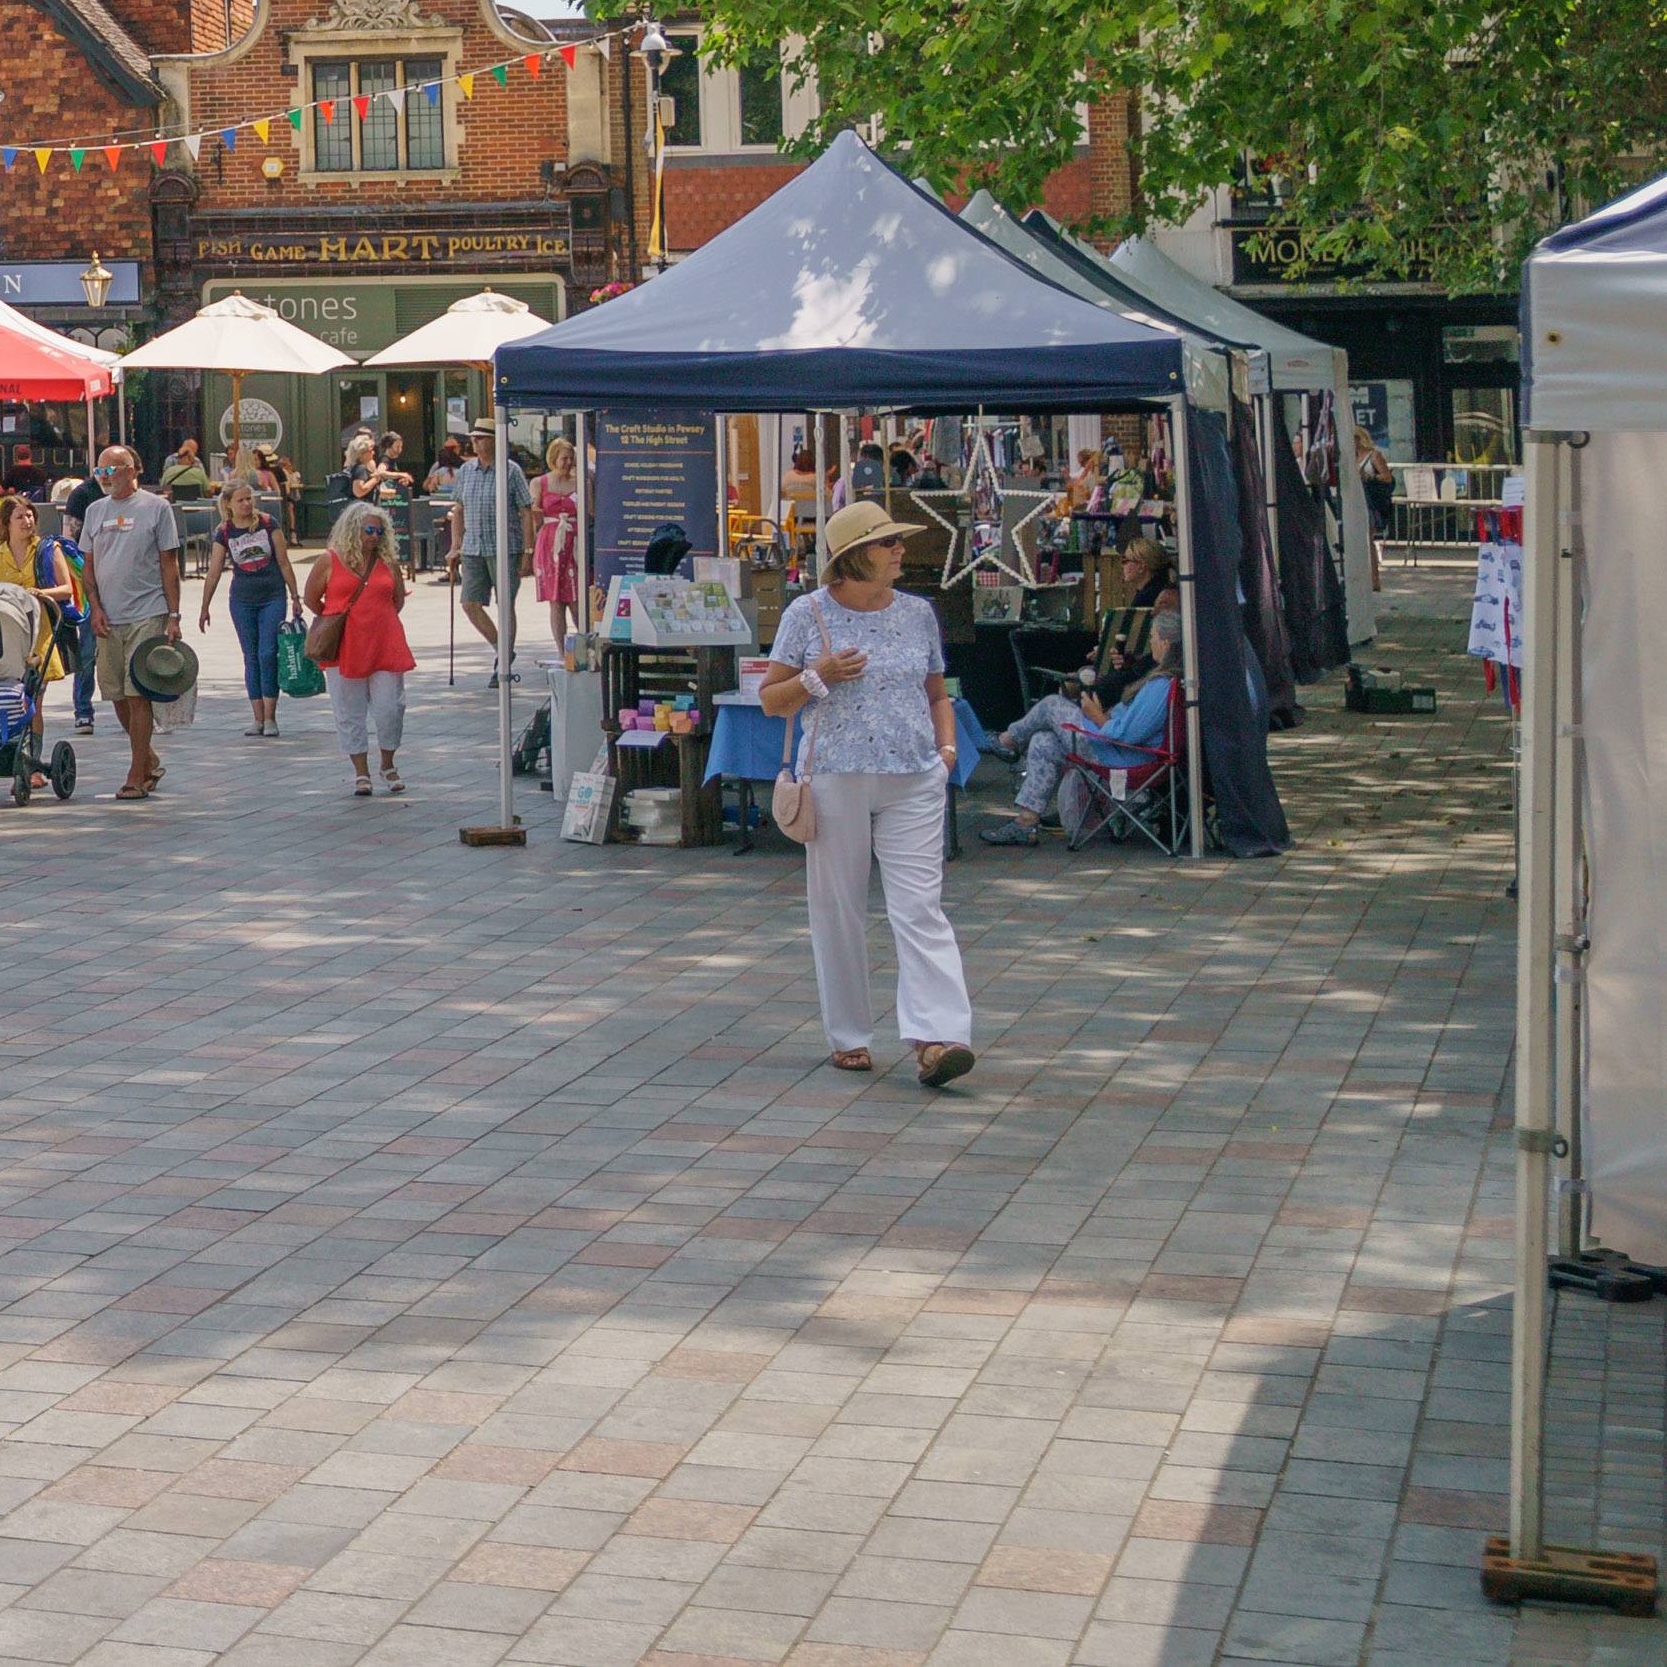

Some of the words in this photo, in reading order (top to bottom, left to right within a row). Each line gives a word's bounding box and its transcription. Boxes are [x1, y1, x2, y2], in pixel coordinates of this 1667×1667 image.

[197, 240, 243, 259] FISH
[250, 242, 306, 261] GAME
[319, 235, 441, 262] HART
[448, 235, 530, 258] POULTRY
[251, 294, 357, 320] tones
[605, 424, 619, 433] The
[620, 424, 641, 433] Craft
[642, 423, 666, 433] Studio
[676, 424, 705, 435] Pewsey
[646, 435, 663, 446] High
[664, 435, 688, 444] Street
[286, 644, 298, 680] habitat
